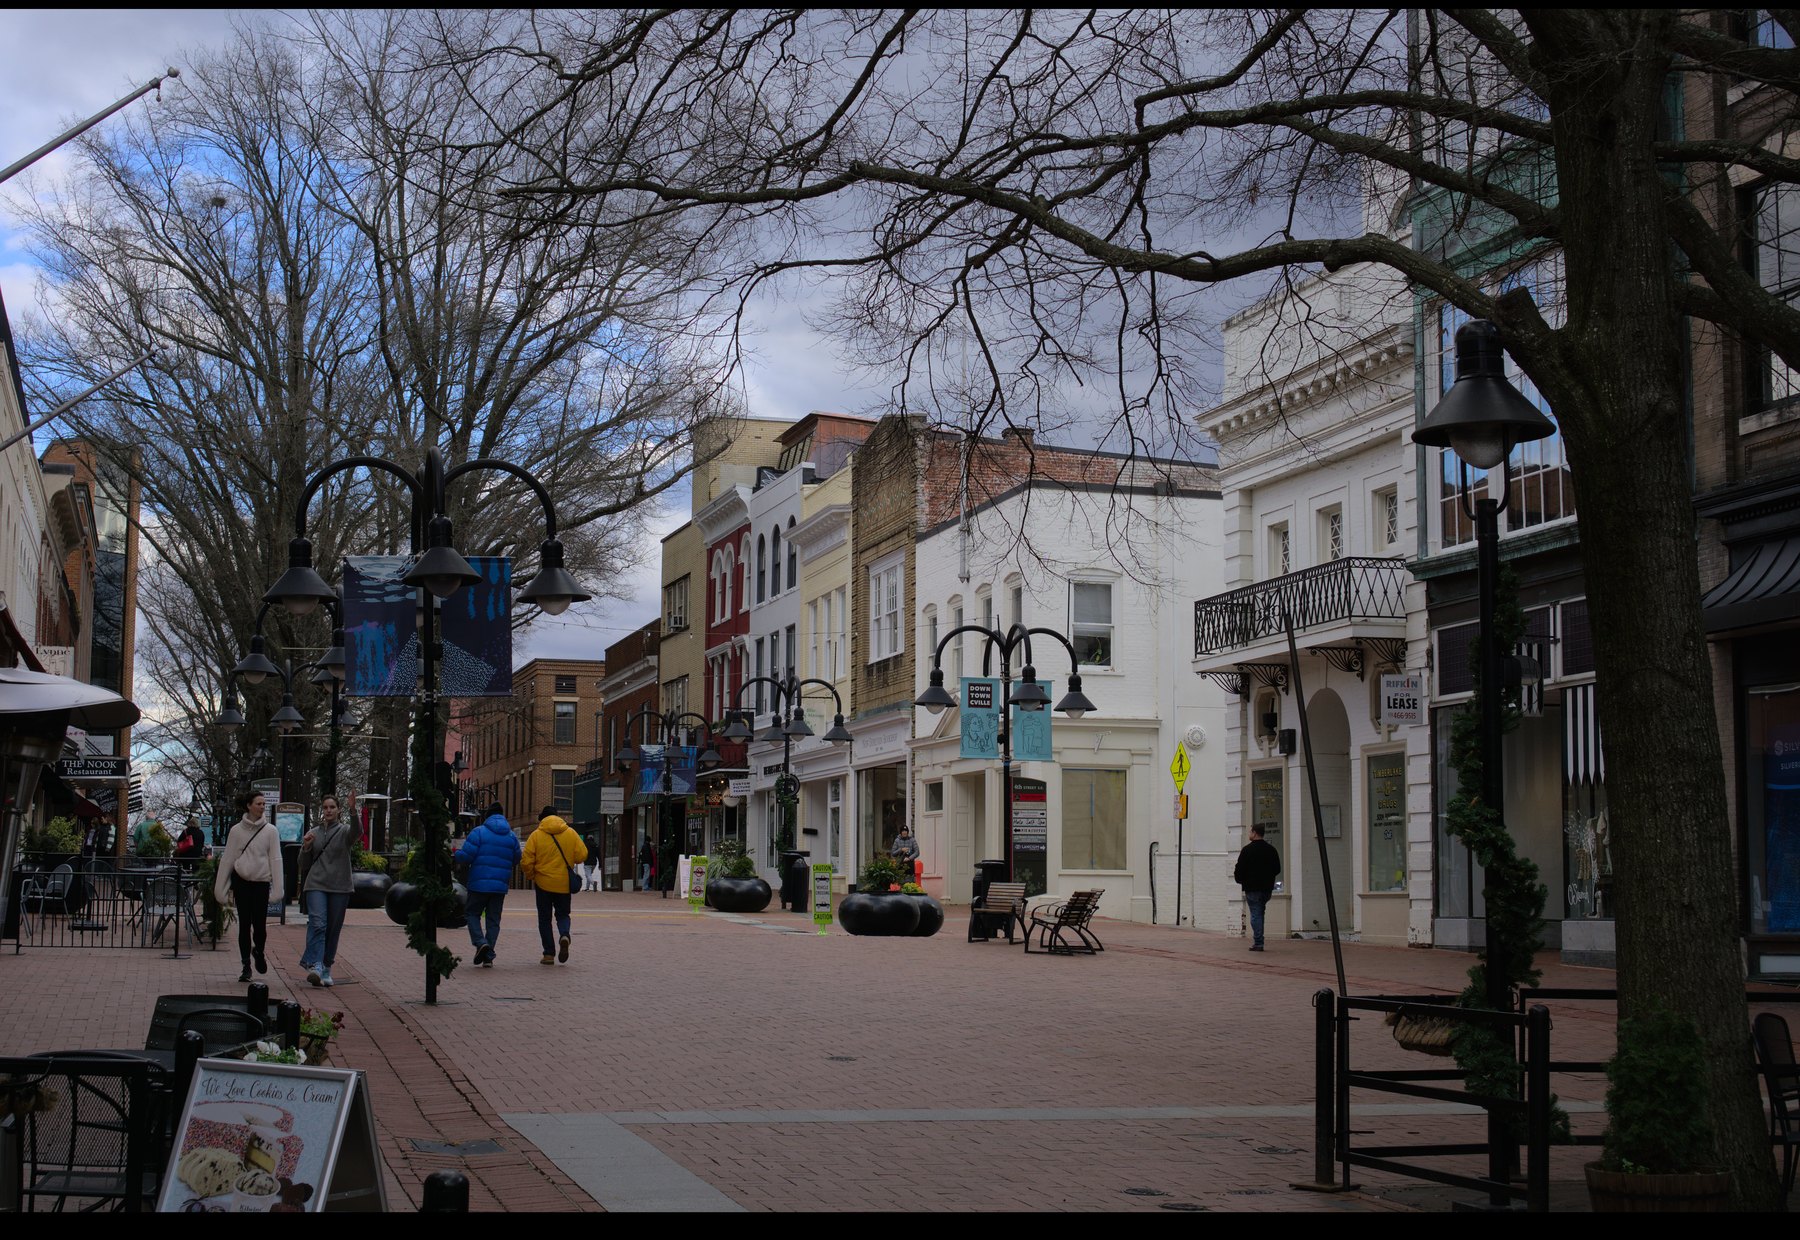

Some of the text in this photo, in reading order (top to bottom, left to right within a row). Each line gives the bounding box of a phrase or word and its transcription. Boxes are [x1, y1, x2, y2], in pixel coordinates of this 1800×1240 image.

[1386, 678, 1418, 688] RIFKIN
[1387, 696, 1418, 709] LEASE
[62, 759, 117, 769] THE NOOK
[202, 1077, 339, 1104] We Love Cookies & Cream!
